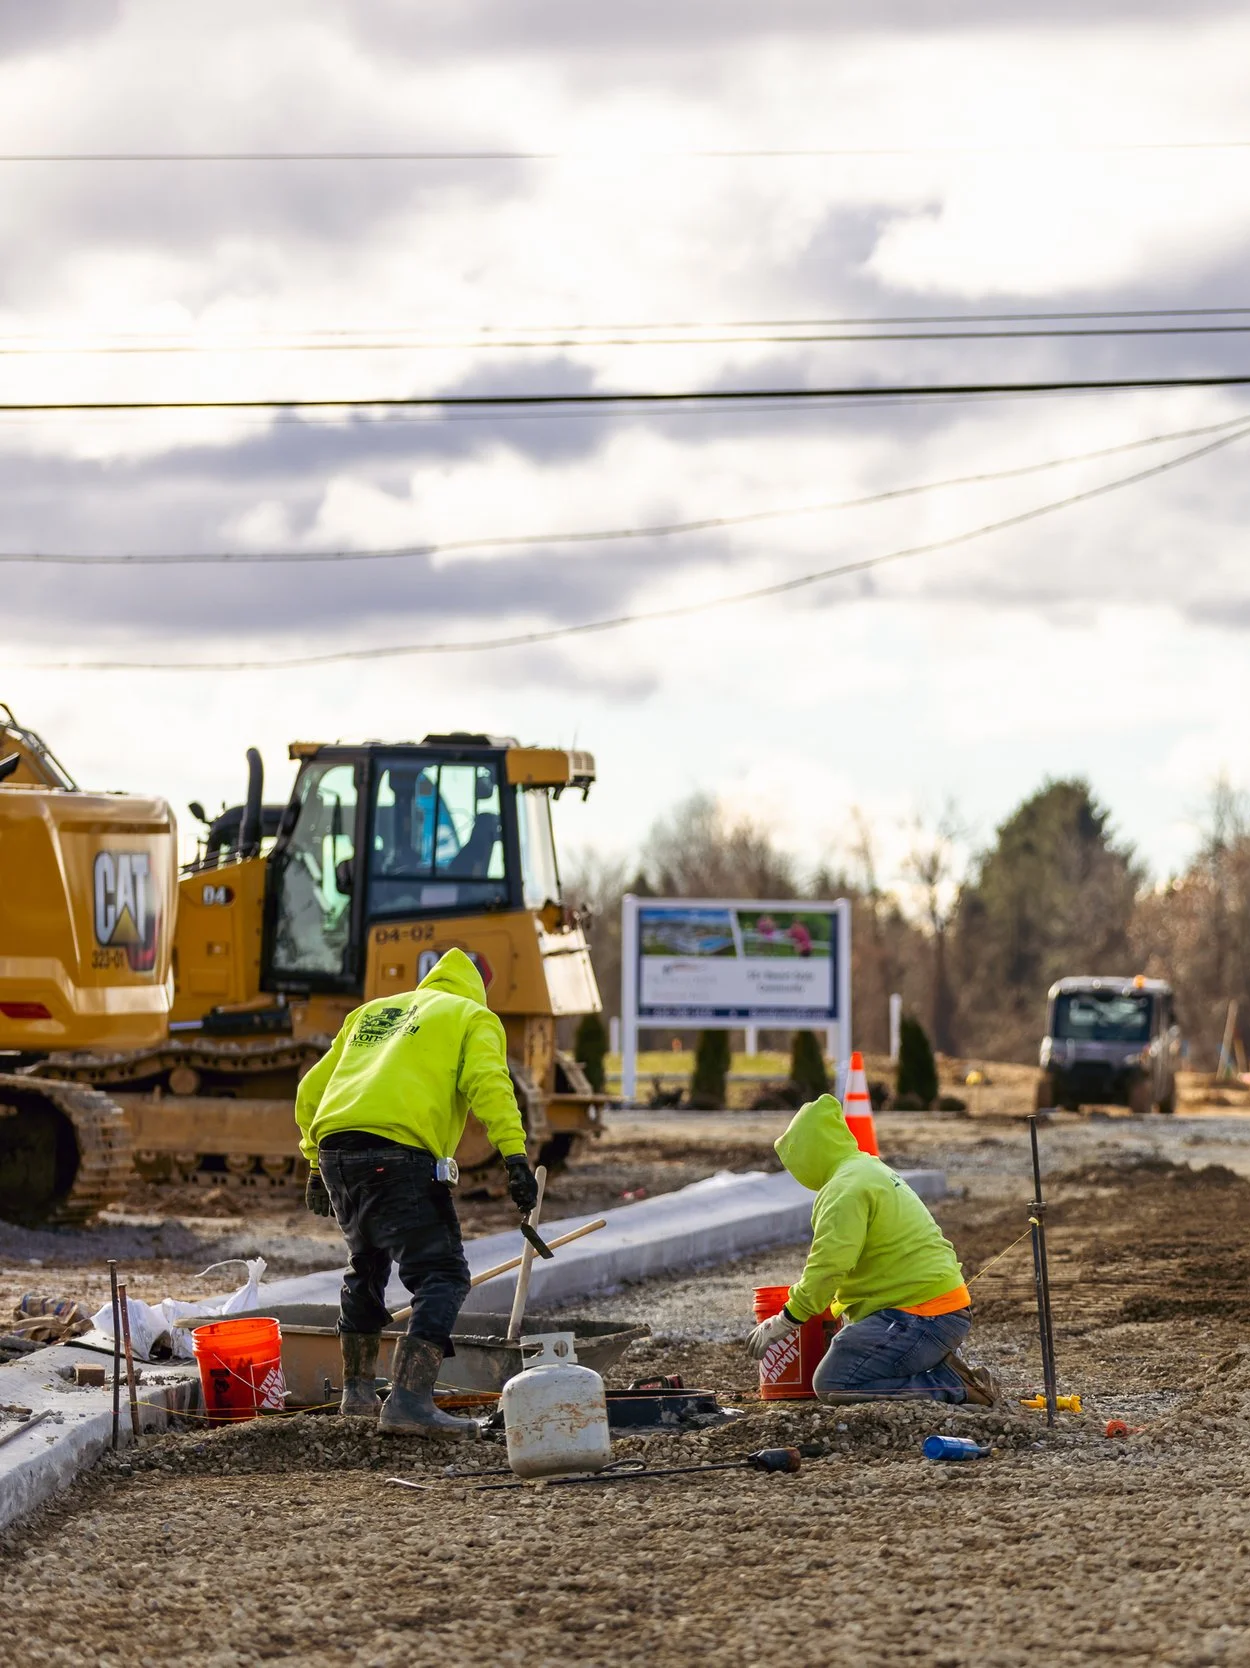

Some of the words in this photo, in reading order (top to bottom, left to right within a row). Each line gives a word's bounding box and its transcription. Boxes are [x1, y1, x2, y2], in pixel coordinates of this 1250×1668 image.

[95, 851, 148, 945] CAT
[203, 885, 226, 905] D4
[768, 1344, 800, 1384] DEPOT
